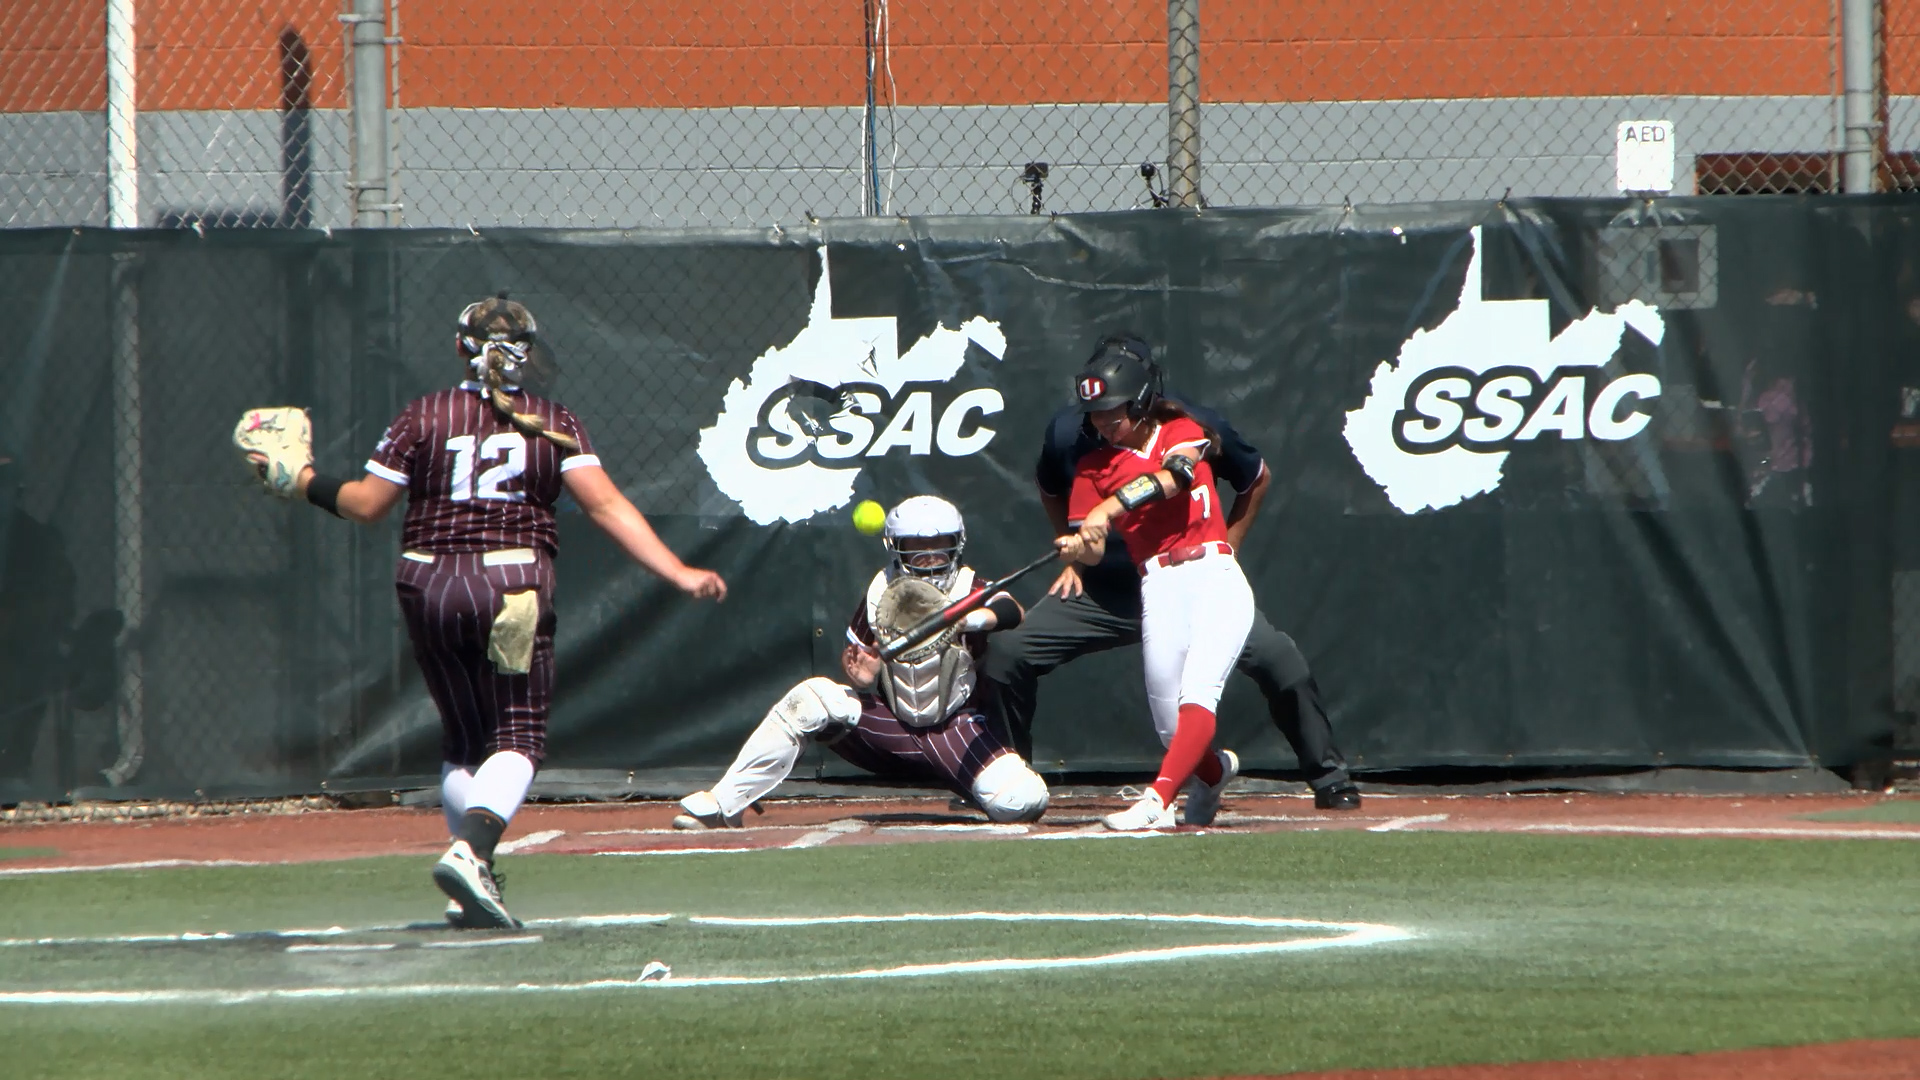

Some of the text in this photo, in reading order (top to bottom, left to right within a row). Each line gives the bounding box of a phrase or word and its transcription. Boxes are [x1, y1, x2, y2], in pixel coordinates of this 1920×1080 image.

[1625, 125, 1666, 142] AED
[756, 387, 1005, 460] SSAC
[1402, 373, 1662, 443] SSAC
[445, 431, 527, 501] 12
[1190, 484, 1211, 519] 7
